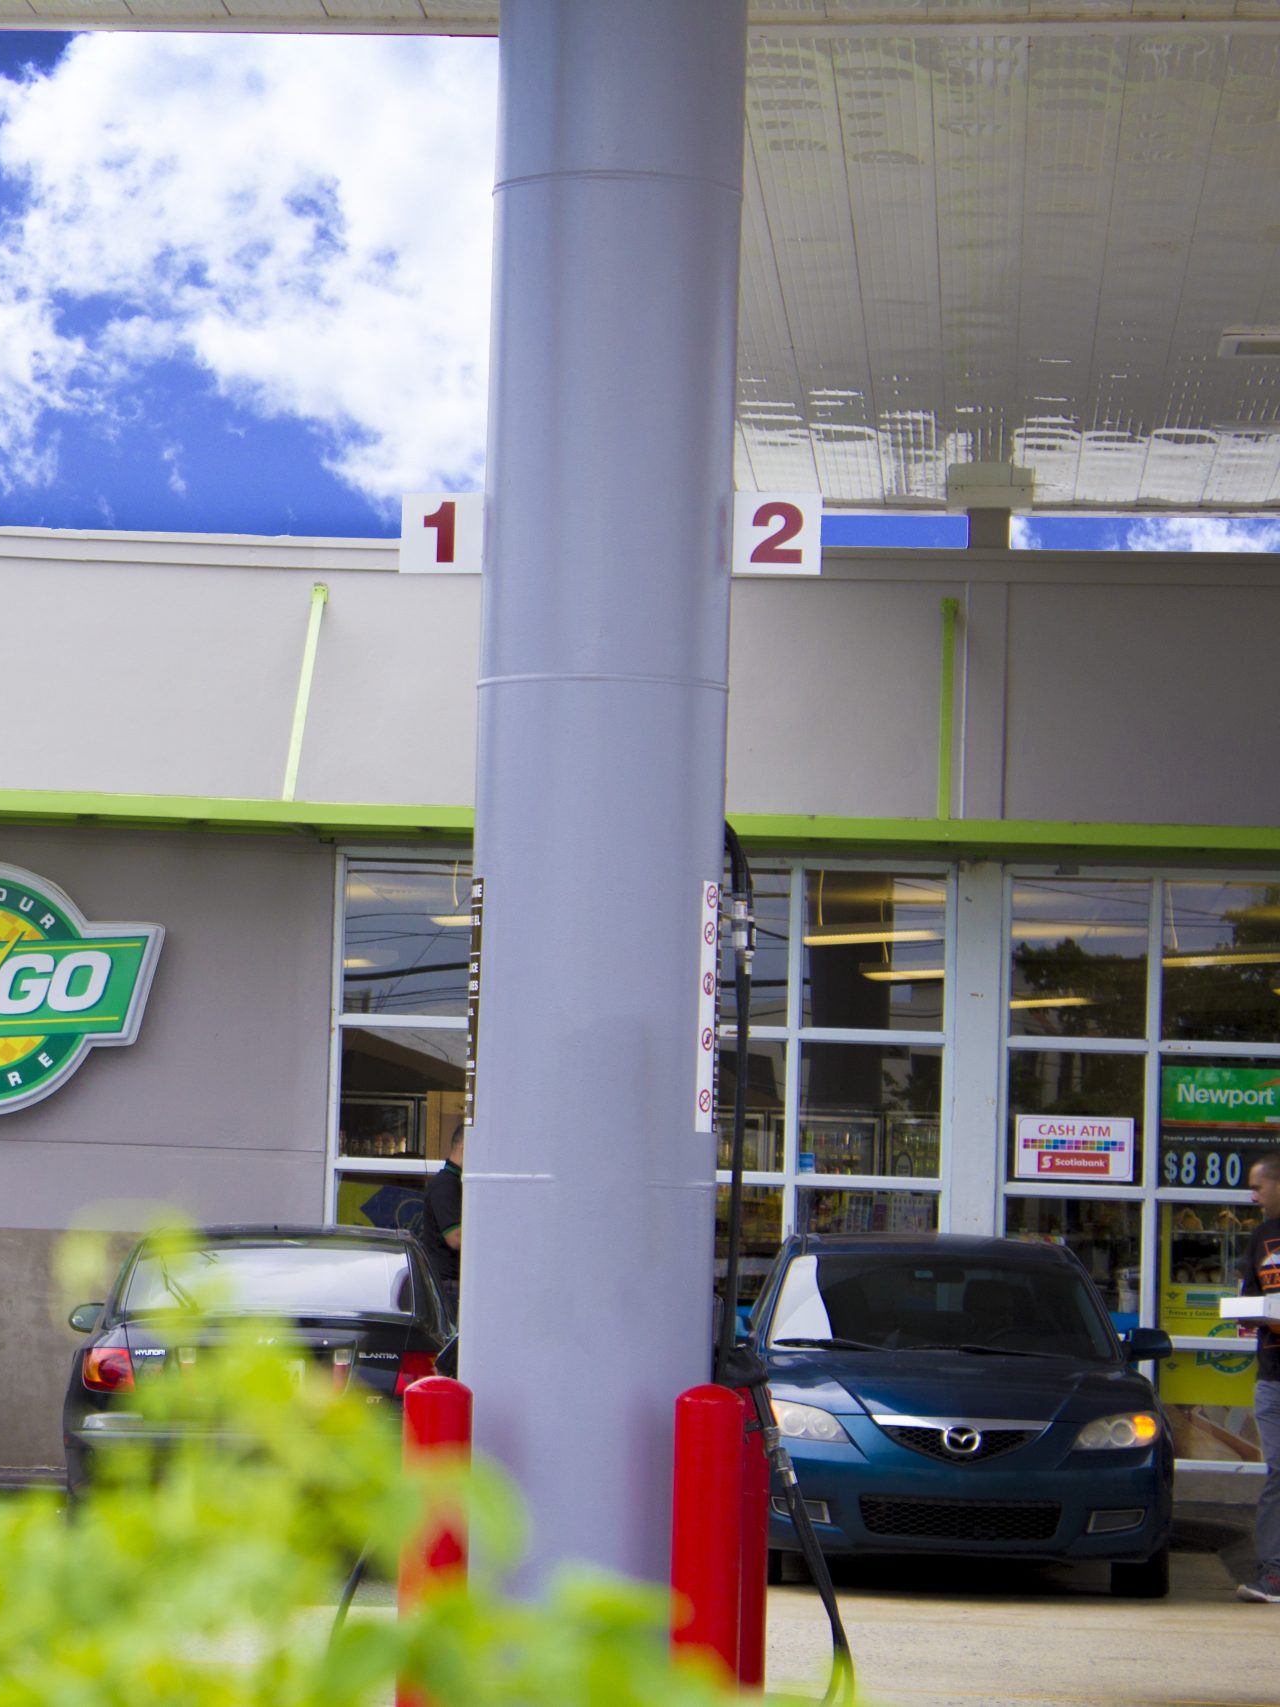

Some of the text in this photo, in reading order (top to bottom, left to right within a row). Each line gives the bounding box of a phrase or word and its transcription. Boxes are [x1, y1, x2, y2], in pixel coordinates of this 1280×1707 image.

[423, 501, 456, 563] 1
[750, 501, 804, 564] 2
[1177, 1083, 1275, 1108] Newport
[1038, 1124, 1112, 1137] CASH ATM
[1055, 1158, 1106, 1167] Scotiabank
[358, 1352, 399, 1360] ELANTRA
